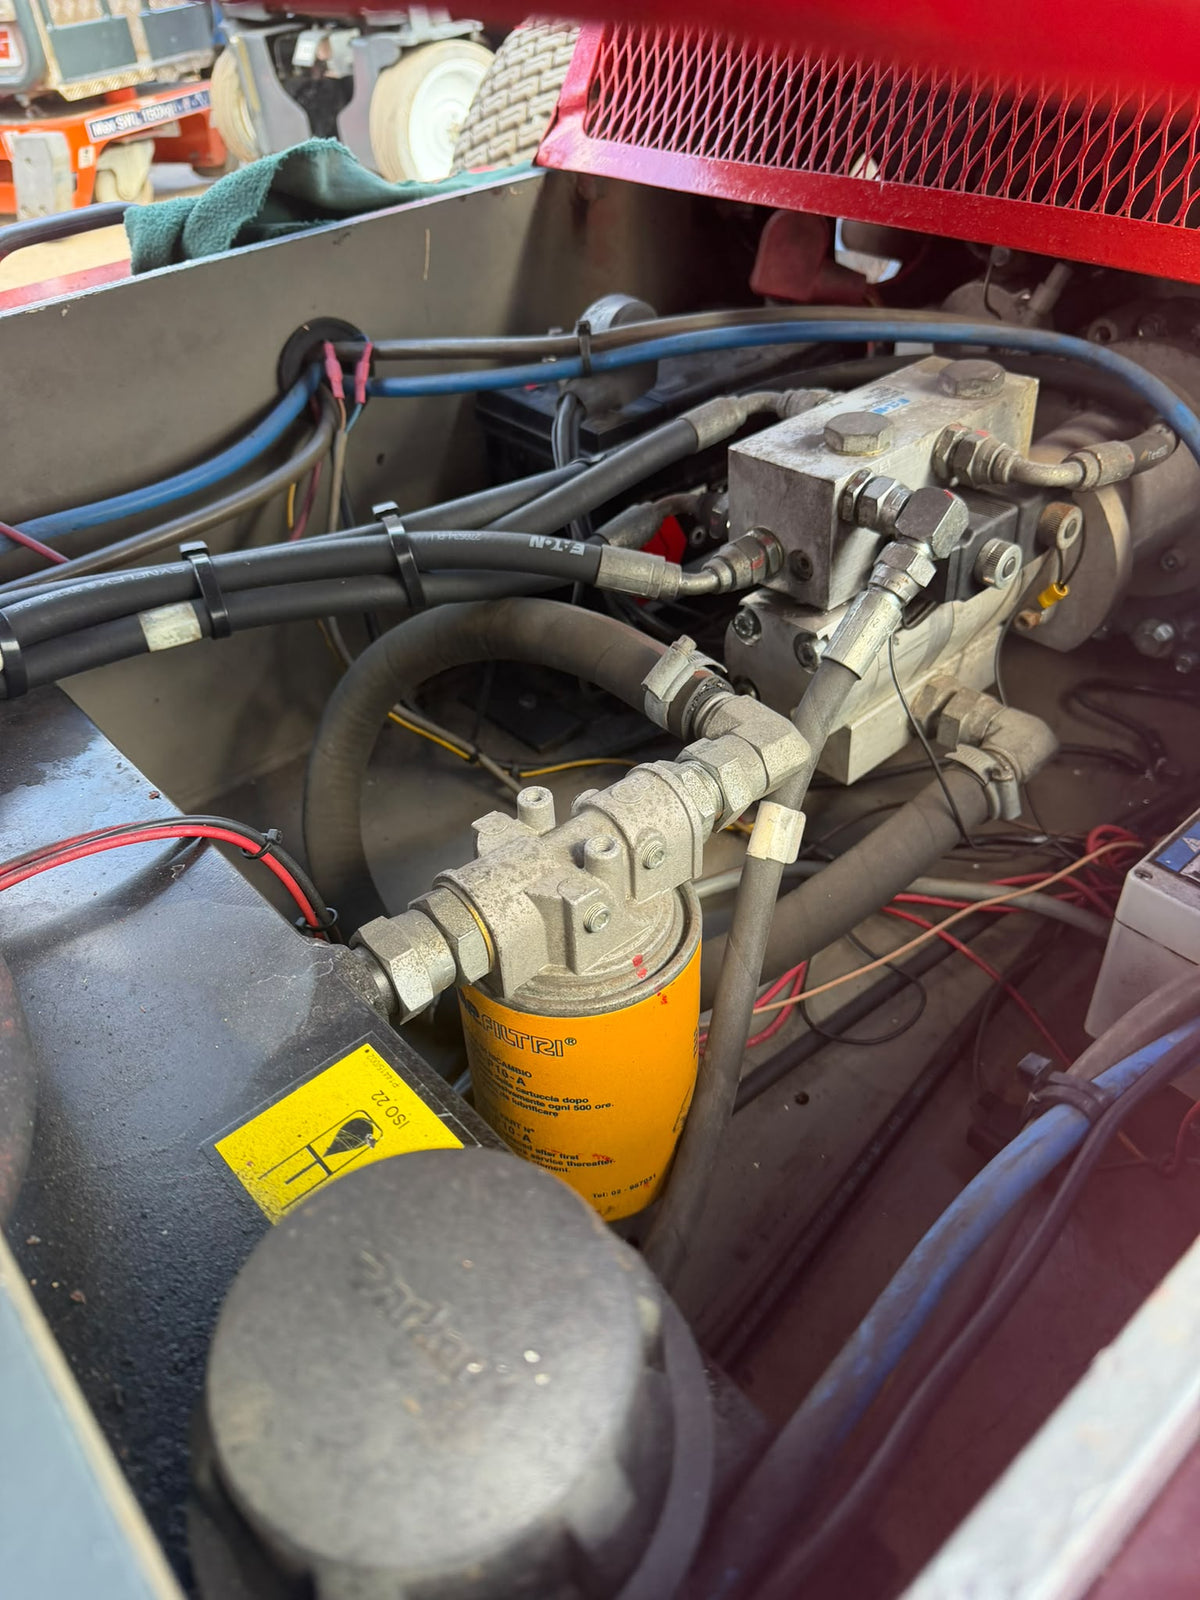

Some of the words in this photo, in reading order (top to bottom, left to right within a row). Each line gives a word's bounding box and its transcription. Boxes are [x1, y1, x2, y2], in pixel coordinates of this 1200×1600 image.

[529, 535, 586, 556] EATON
[371, 1089, 390, 1107] 22
[515, 1086, 560, 1103] cartuccia
[562, 1096, 589, 1107] dopo
[548, 1100, 570, 1112] ogni
[385, 1105, 410, 1129] ISO
[559, 1152, 579, 1161] first
